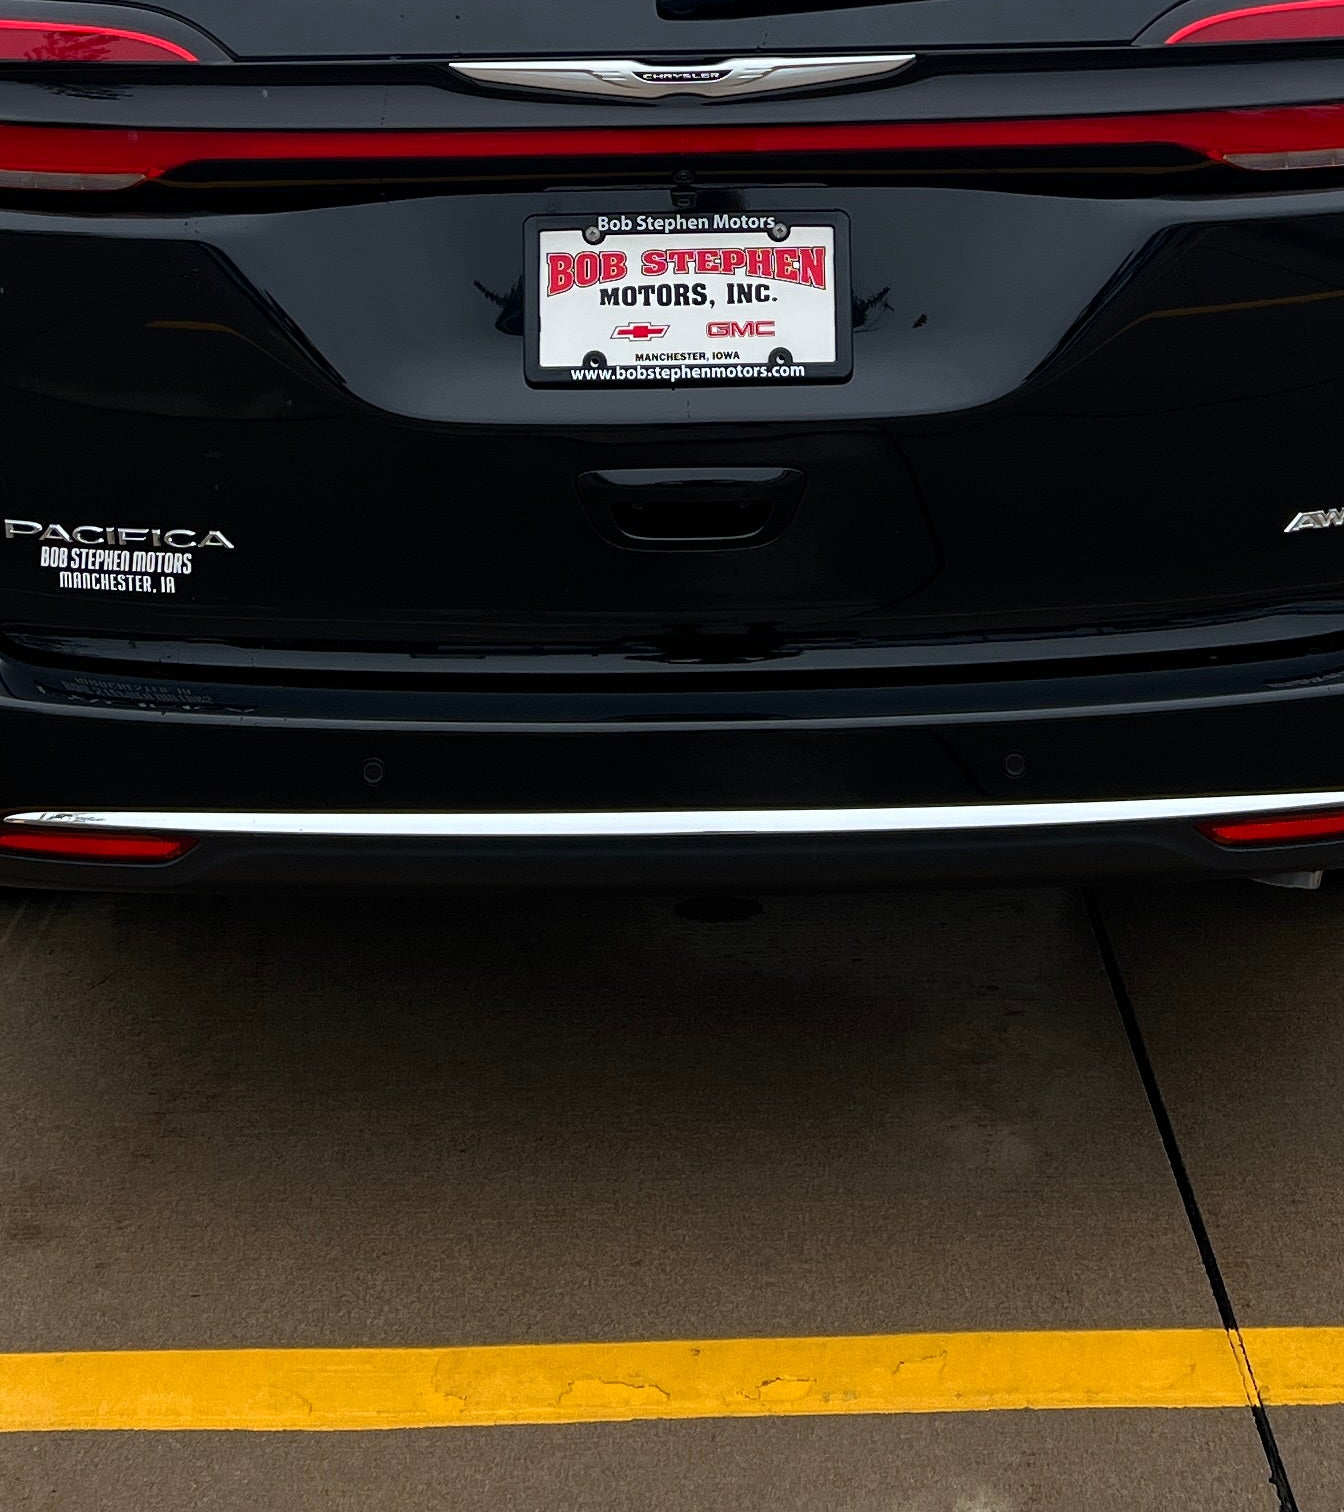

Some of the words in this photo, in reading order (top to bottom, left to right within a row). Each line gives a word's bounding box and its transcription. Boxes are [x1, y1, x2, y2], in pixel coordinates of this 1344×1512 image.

[642, 72, 720, 80] CHRYSLER
[597, 215, 633, 231] Bob
[636, 214, 709, 233] Stephen
[713, 214, 776, 230] Motors
[546, 251, 628, 297] BOB
[641, 246, 826, 290] STEPHEN
[599, 283, 716, 309] MOTORS,
[726, 283, 778, 305] INC.
[706, 320, 776, 338] GMC
[635, 352, 709, 362] MANCHESTER,
[712, 351, 741, 361] IOWA
[570, 363, 806, 382] www.bobstephenmotors.com
[4, 519, 235, 549] PACIFICA
[40, 546, 68, 568] BOB
[70, 548, 130, 571] STEPHEN
[131, 551, 193, 574] MOTORS
[160, 576, 176, 593] IA
